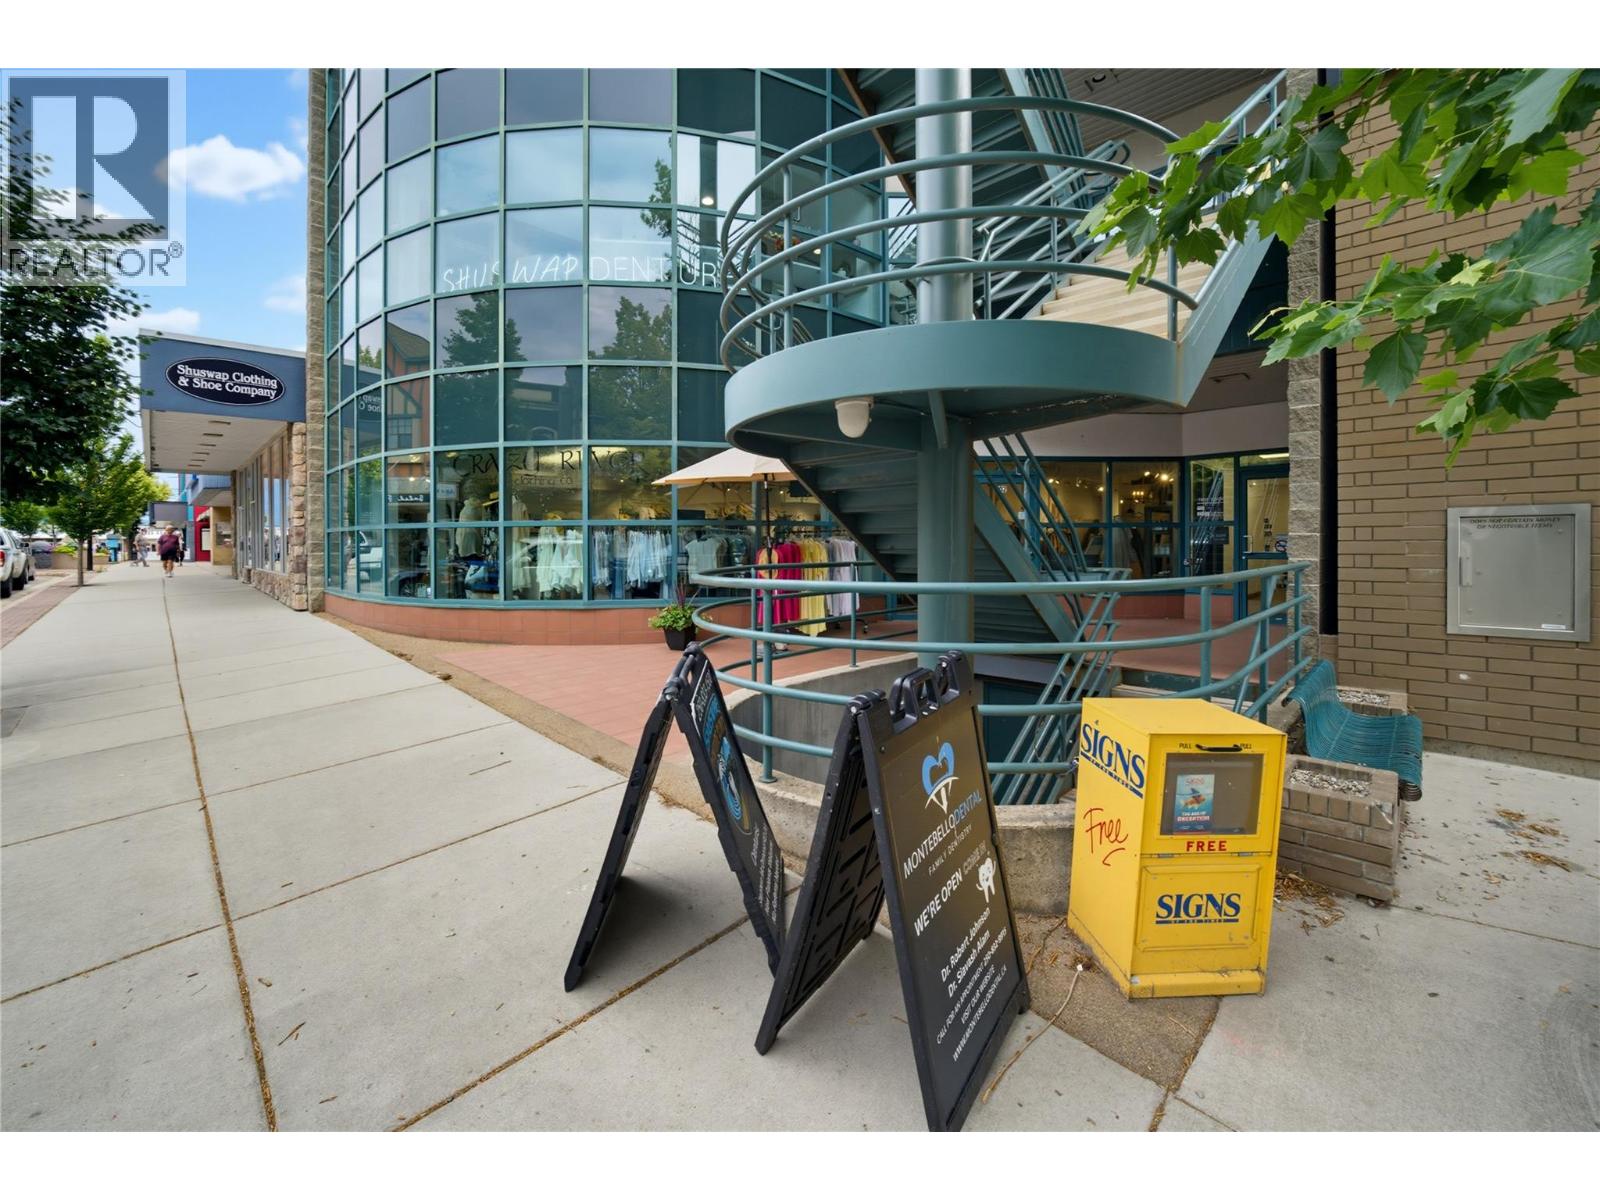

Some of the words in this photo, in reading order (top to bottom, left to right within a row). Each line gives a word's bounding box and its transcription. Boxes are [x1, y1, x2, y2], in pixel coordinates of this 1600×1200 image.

[177, 364, 229, 382] Shuswap
[232, 372, 278, 389] Clothing
[178, 376, 189, 387] &
[192, 378, 222, 391] Shoe
[225, 382, 277, 399] Company
[1081, 721, 1145, 789] SIGNS
[1083, 808, 1128, 853] Free
[1186, 840, 1227, 852] FREE
[928, 849, 947, 876] FAMILY
[914, 894, 942, 937] WE'RE
[941, 868, 963, 903] OPEN
[1156, 893, 1241, 918] SIGNS
[941, 965, 951, 982] Dr.
[950, 936, 969, 968] Robert
[969, 907, 991, 941] Johnson
[948, 981, 958, 998] Dr.
[936, 1025, 947, 1044] CALL
